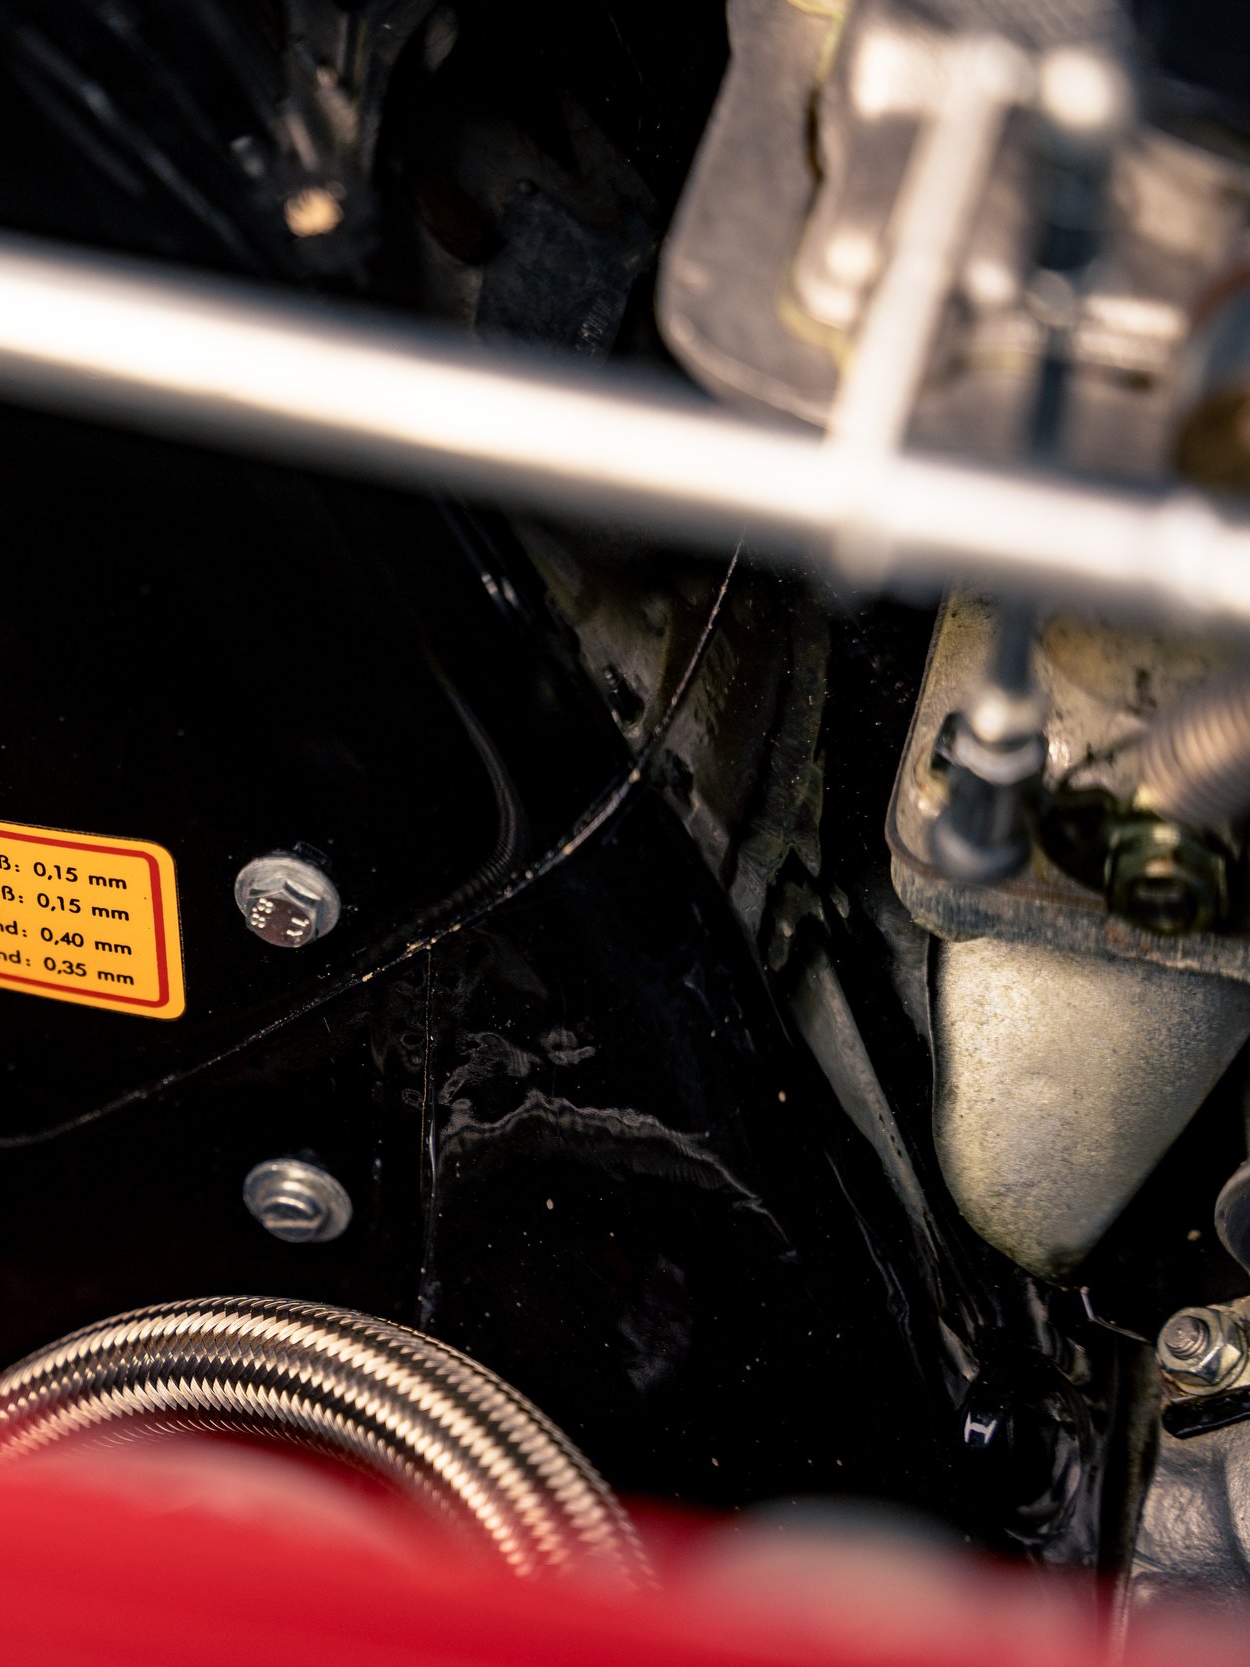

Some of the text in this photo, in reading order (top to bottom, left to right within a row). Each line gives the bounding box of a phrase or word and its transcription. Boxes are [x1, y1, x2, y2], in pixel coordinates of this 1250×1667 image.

[33, 861, 78, 883] 0,15
[88, 875, 127, 890] mm
[36, 892, 82, 914] 0,15
[91, 906, 130, 922] mm
[40, 927, 84, 948] 0,40
[94, 940, 133, 956] mm
[43, 956, 87, 977] 0,35
[97, 970, 135, 987] mm
